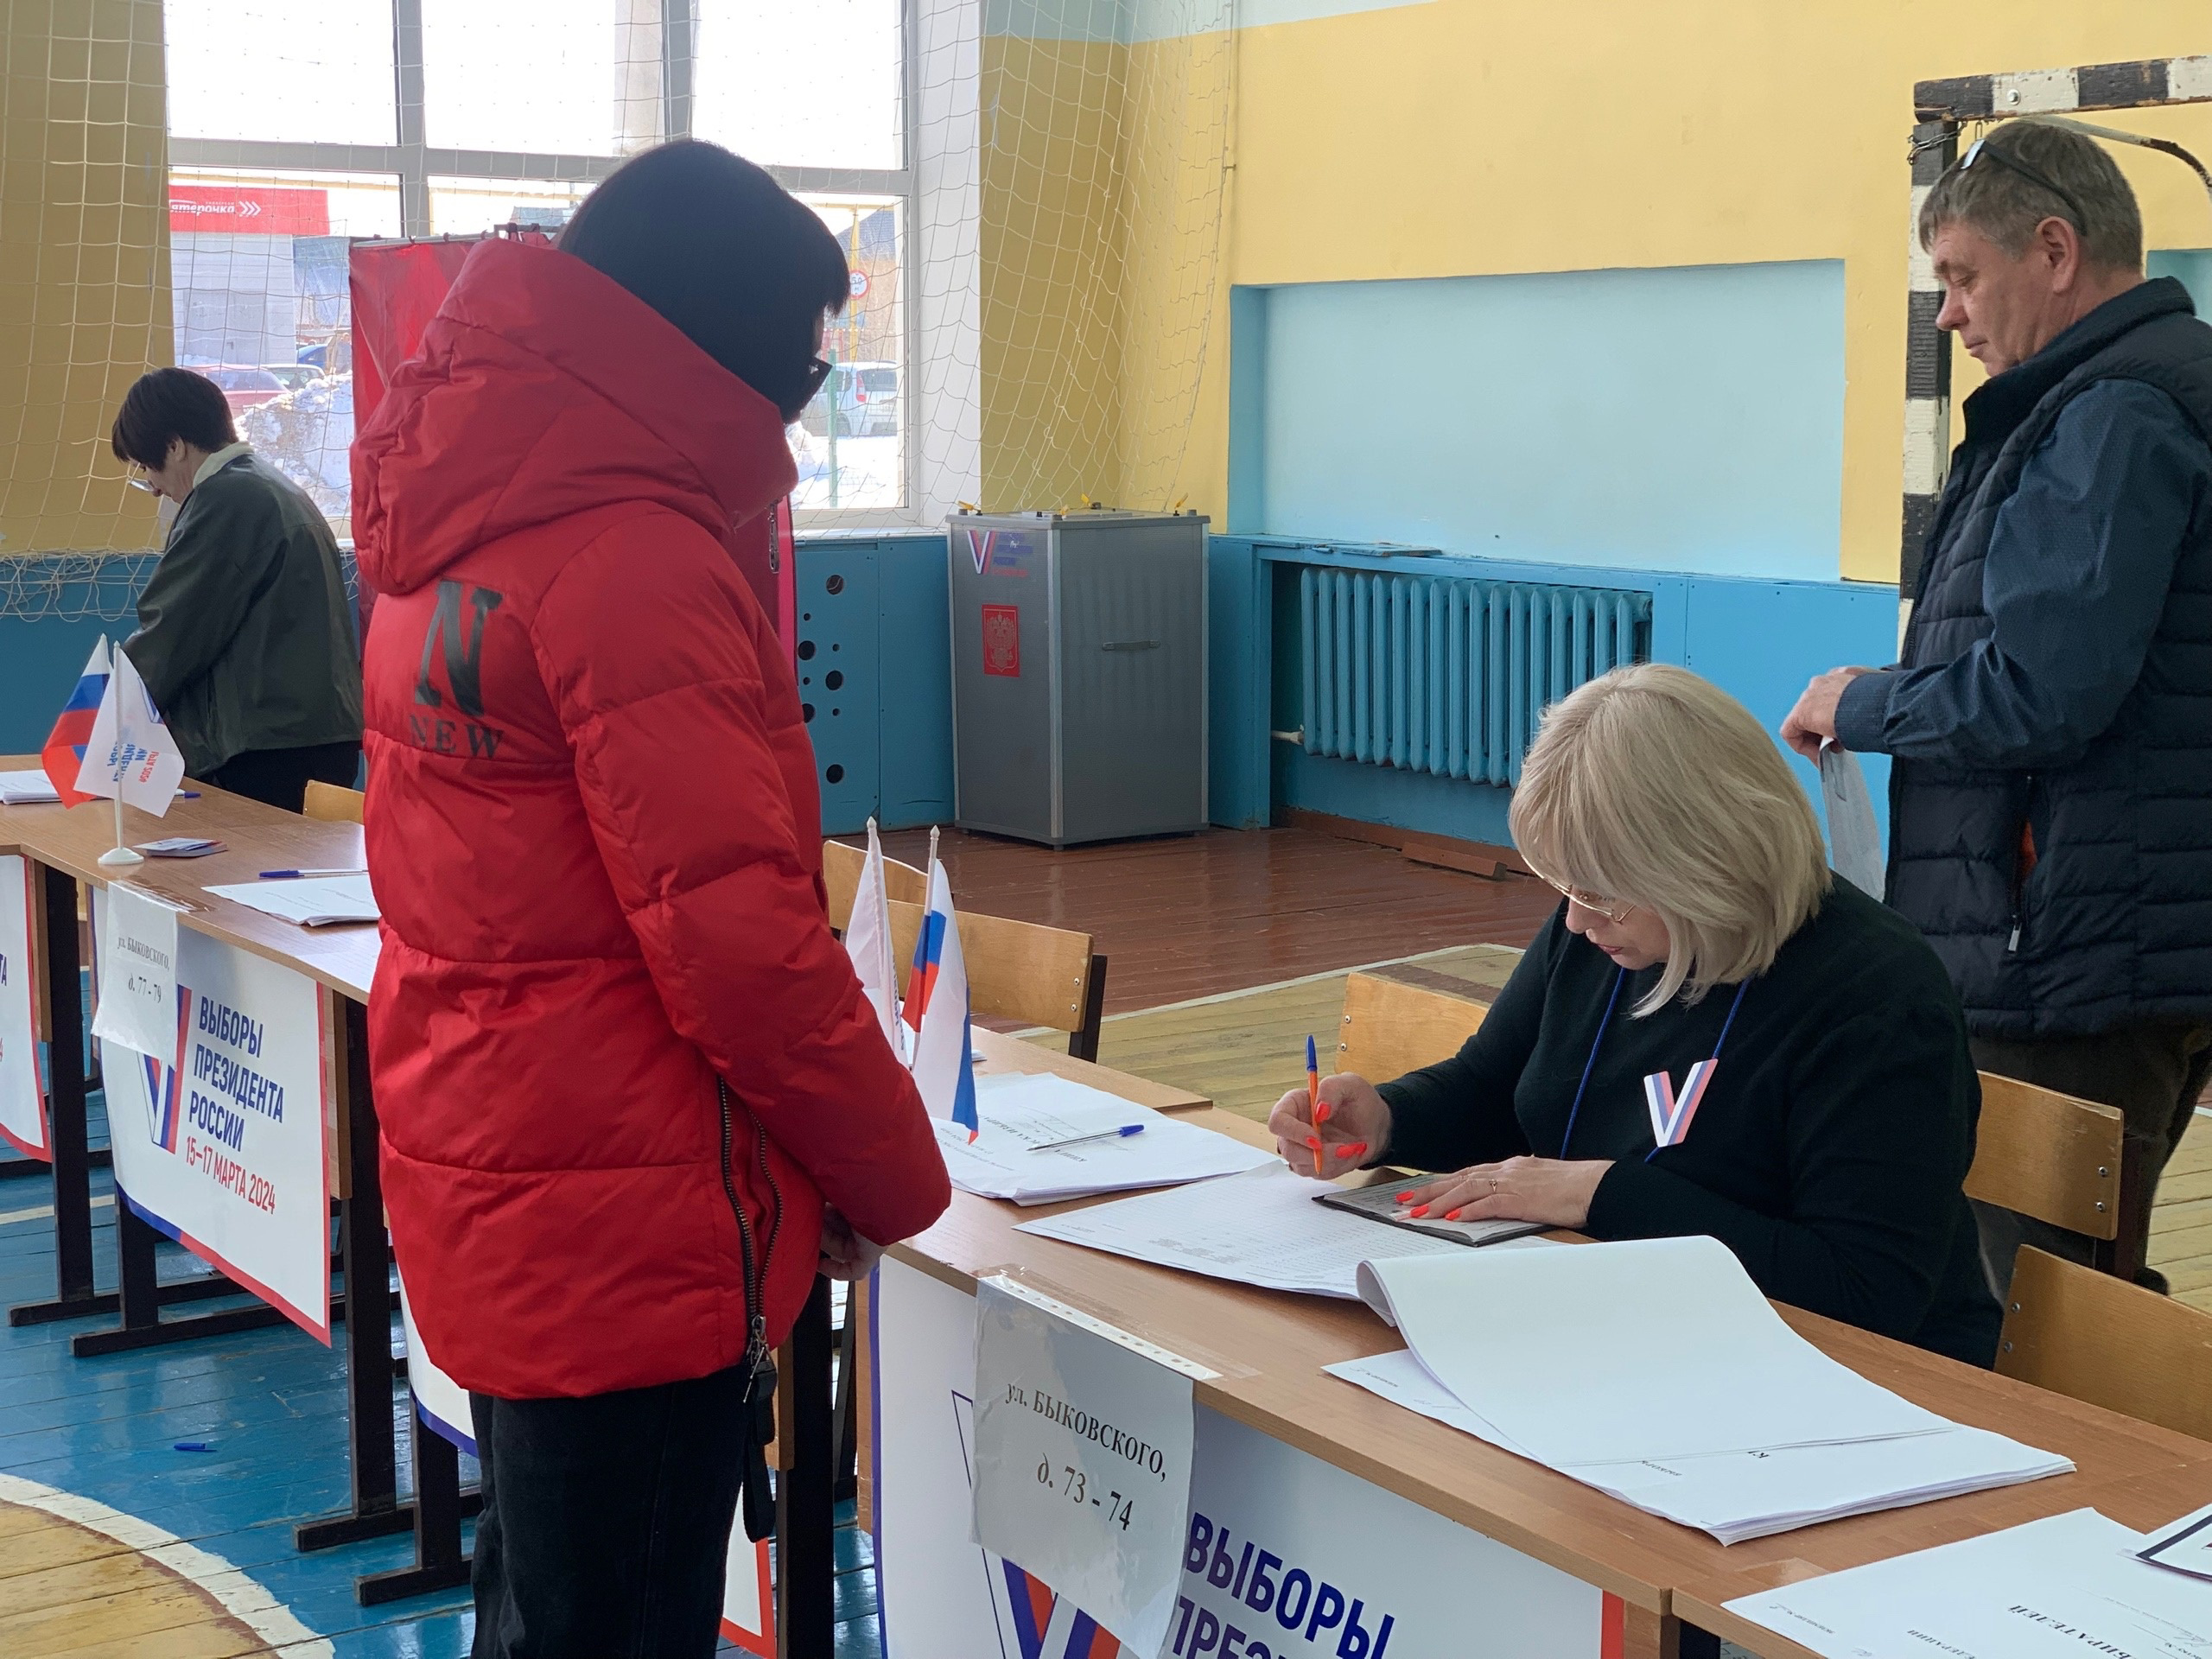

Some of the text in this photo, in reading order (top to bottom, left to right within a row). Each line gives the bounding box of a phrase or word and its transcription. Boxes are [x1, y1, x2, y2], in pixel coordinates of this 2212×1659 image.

[168, 199, 235, 216] ятерочка
[410, 715, 504, 760] NEW
[127, 937, 169, 972] БЫКОВСКОГО,
[138, 976, 147, 995] 77
[154, 984, 162, 1003] 79
[200, 995, 264, 1058] ВЫБОРЫ
[194, 1043, 283, 1123] ПРЕЗИДЕНТА
[189, 1090, 245, 1152] РОССИИ
[213, 1152, 246, 1199] МАРТА
[248, 1173, 276, 1215] 2024
[1005, 1383, 1166, 1483] ул. БЫКОВСКОГО,
[1038, 1452, 1053, 1488] д.
[1065, 1465, 1086, 1503] 73
[1109, 1491, 1134, 1531] 74
[1186, 1511, 1395, 1659] ВЫБОРЫ
